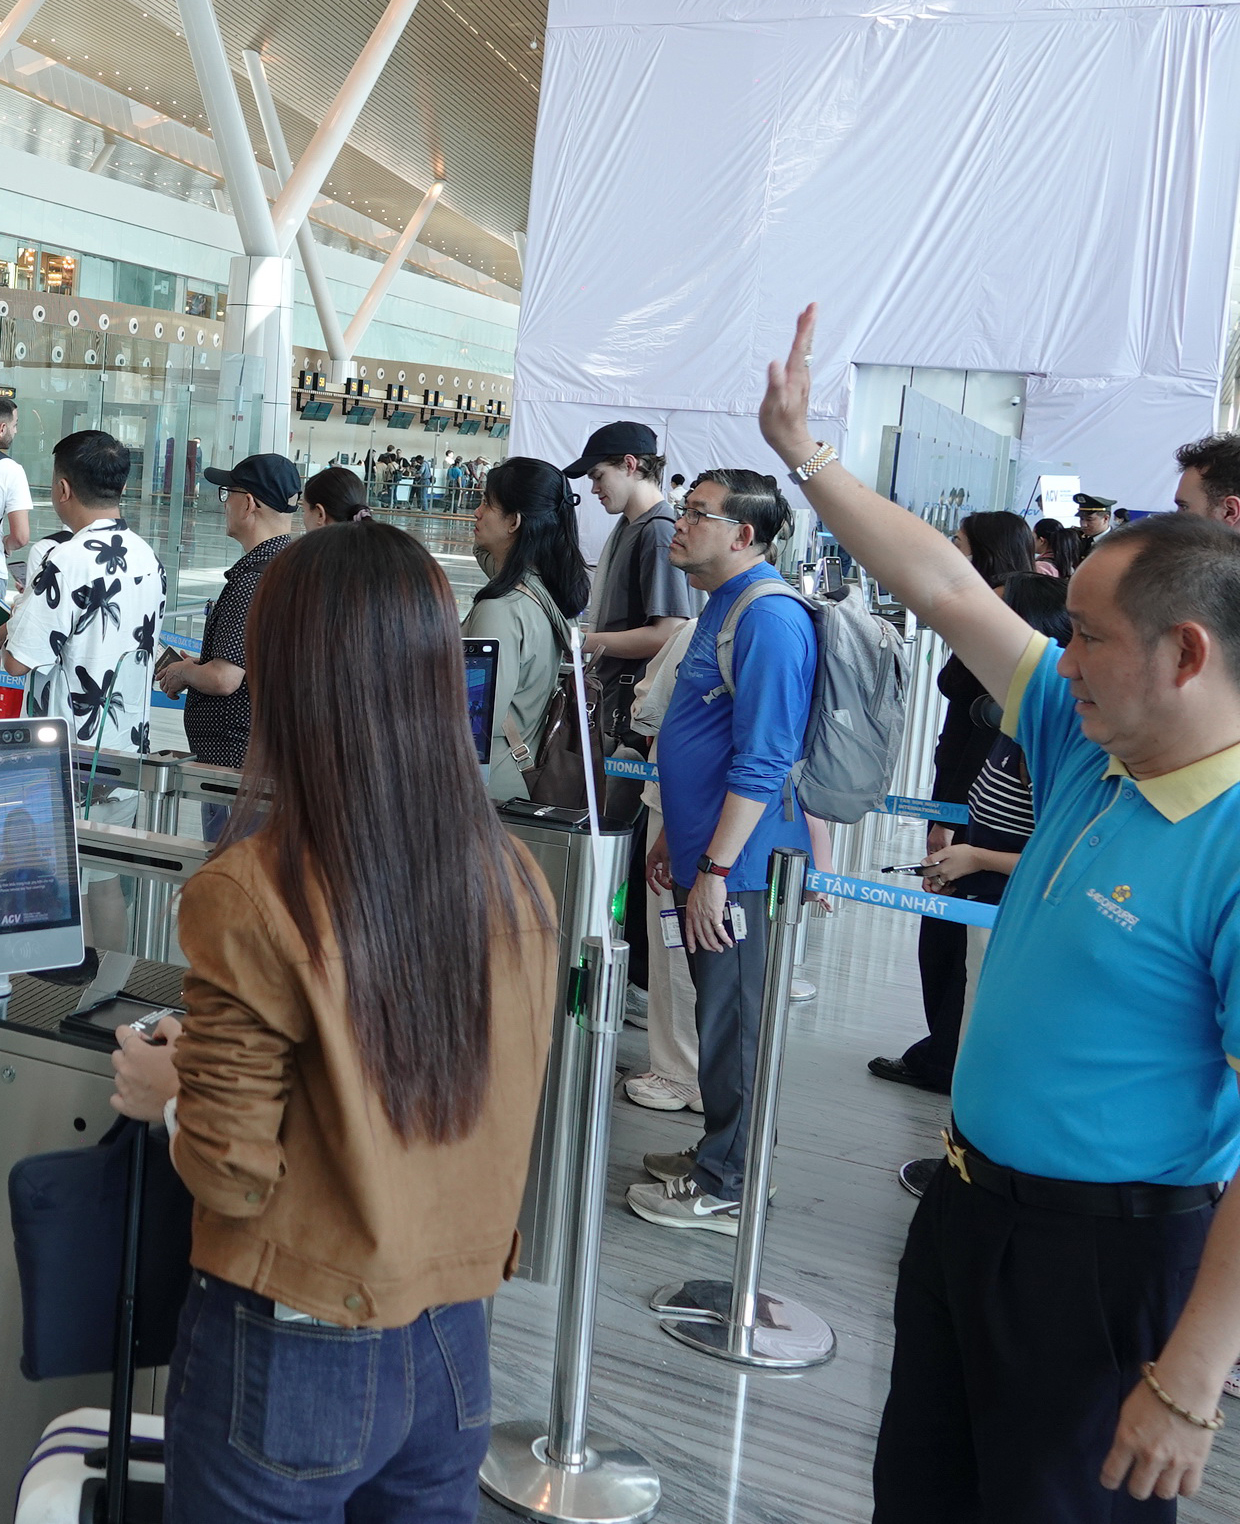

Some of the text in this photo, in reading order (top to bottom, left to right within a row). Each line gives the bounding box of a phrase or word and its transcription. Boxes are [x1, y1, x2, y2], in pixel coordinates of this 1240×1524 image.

[898, 805, 941, 814] INTERNATIONAL
[824, 877, 855, 897] TÂN
[860, 887, 895, 905] SƠN
[901, 896, 948, 915] NHẤT
[1, 914, 21, 925] ACV
[1096, 906, 1132, 932] TRAVEL
